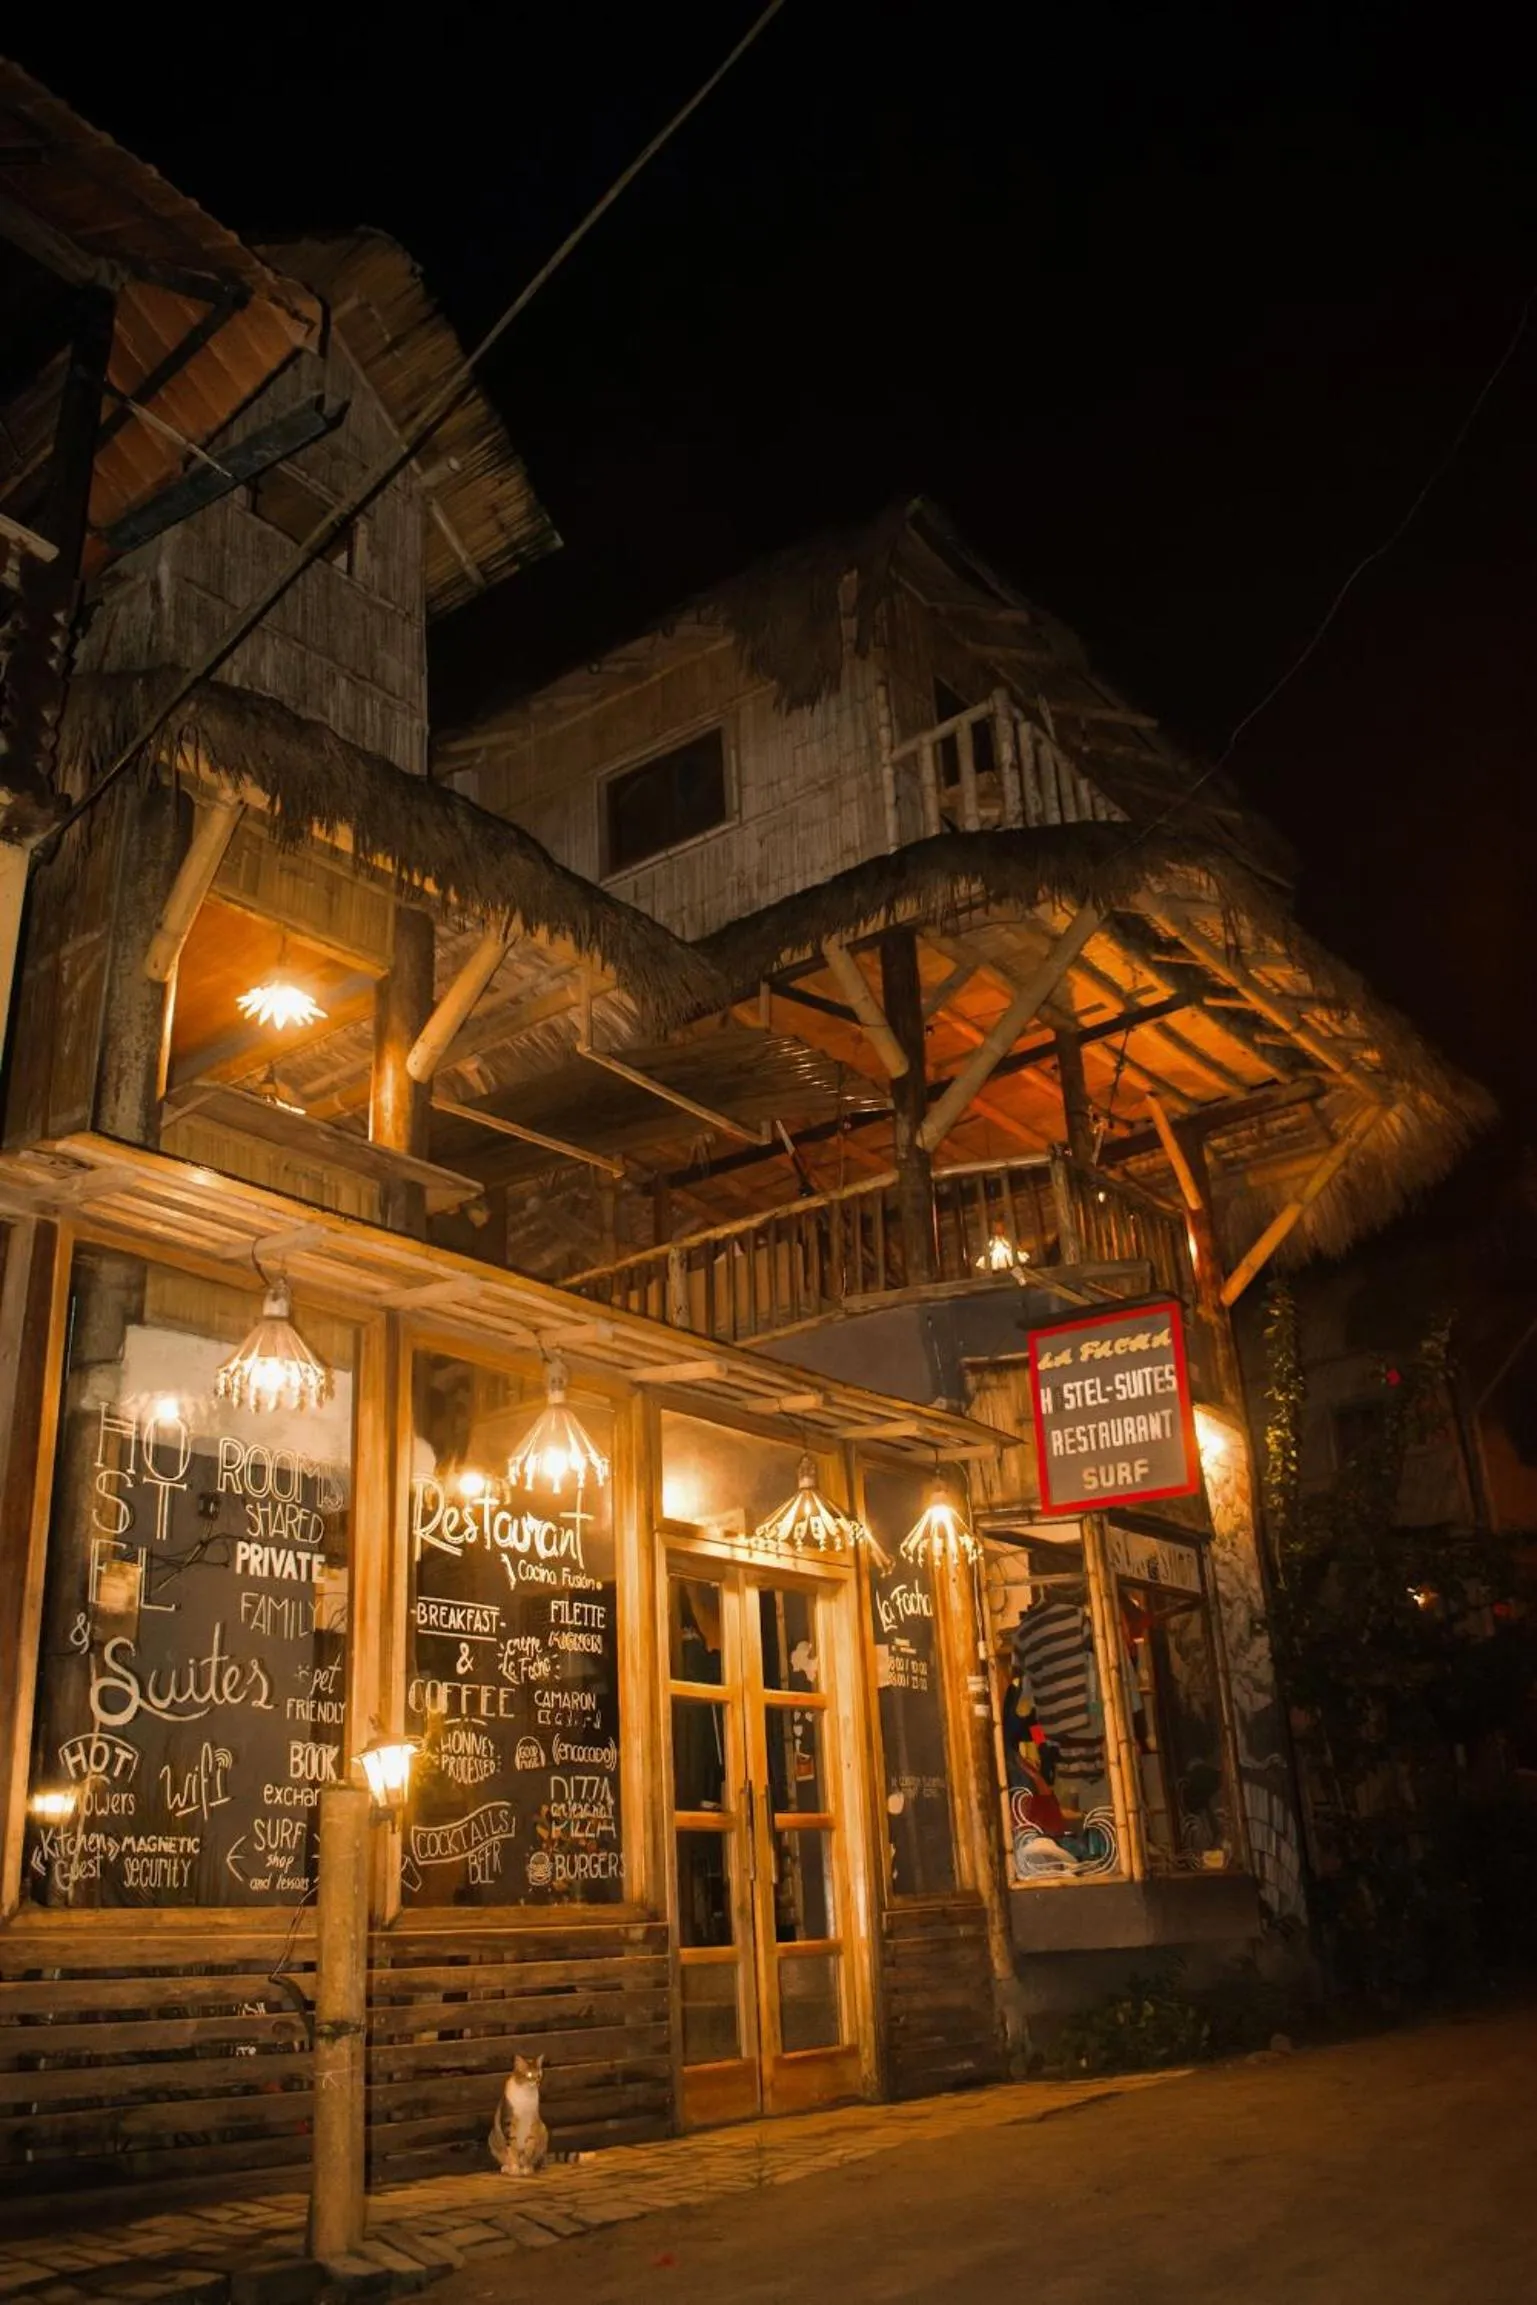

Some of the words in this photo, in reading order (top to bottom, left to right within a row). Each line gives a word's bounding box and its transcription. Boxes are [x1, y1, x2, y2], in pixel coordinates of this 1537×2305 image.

[1051, 1408, 1173, 1456] RESTAURANT
[217, 1437, 344, 1511] ROOMS
[1082, 1458, 1149, 1490] SURF
[245, 1502, 324, 1545] SHARED
[412, 1472, 594, 1570] Restaurant
[236, 1540, 325, 1584] PRIVATE
[518, 1560, 557, 1585] Cocina
[240, 1591, 320, 1640] FAMILY
[417, 1602, 499, 1633] BREAKFAST
[550, 1600, 606, 1629] FILETTE
[876, 1589, 898, 1633] La
[70, 1612, 90, 1654] &
[90, 1622, 274, 1725] Suites
[309, 1655, 342, 1696] pet
[456, 1642, 474, 1674] &
[287, 1697, 346, 1725] FRIENDLY
[409, 1679, 515, 1718] COFFEE
[534, 1690, 597, 1711] CAMARON
[63, 1740, 134, 1779] HOT
[290, 1741, 340, 1781] BOOK
[440, 1730, 494, 1757] HONNEY
[441, 1754, 496, 1784] PROCESSED
[40, 1827, 107, 1860] Kitchen
[121, 1834, 200, 1854] MAGNETIC
[253, 1818, 306, 1850] SURF
[416, 1809, 509, 1858] COCKTAILS
[54, 1854, 103, 1892] Guest
[265, 1853, 294, 1872] shop
[468, 1841, 502, 1885] BEER
[555, 1852, 625, 1880] BURGERS
[250, 1875, 271, 1891] and
